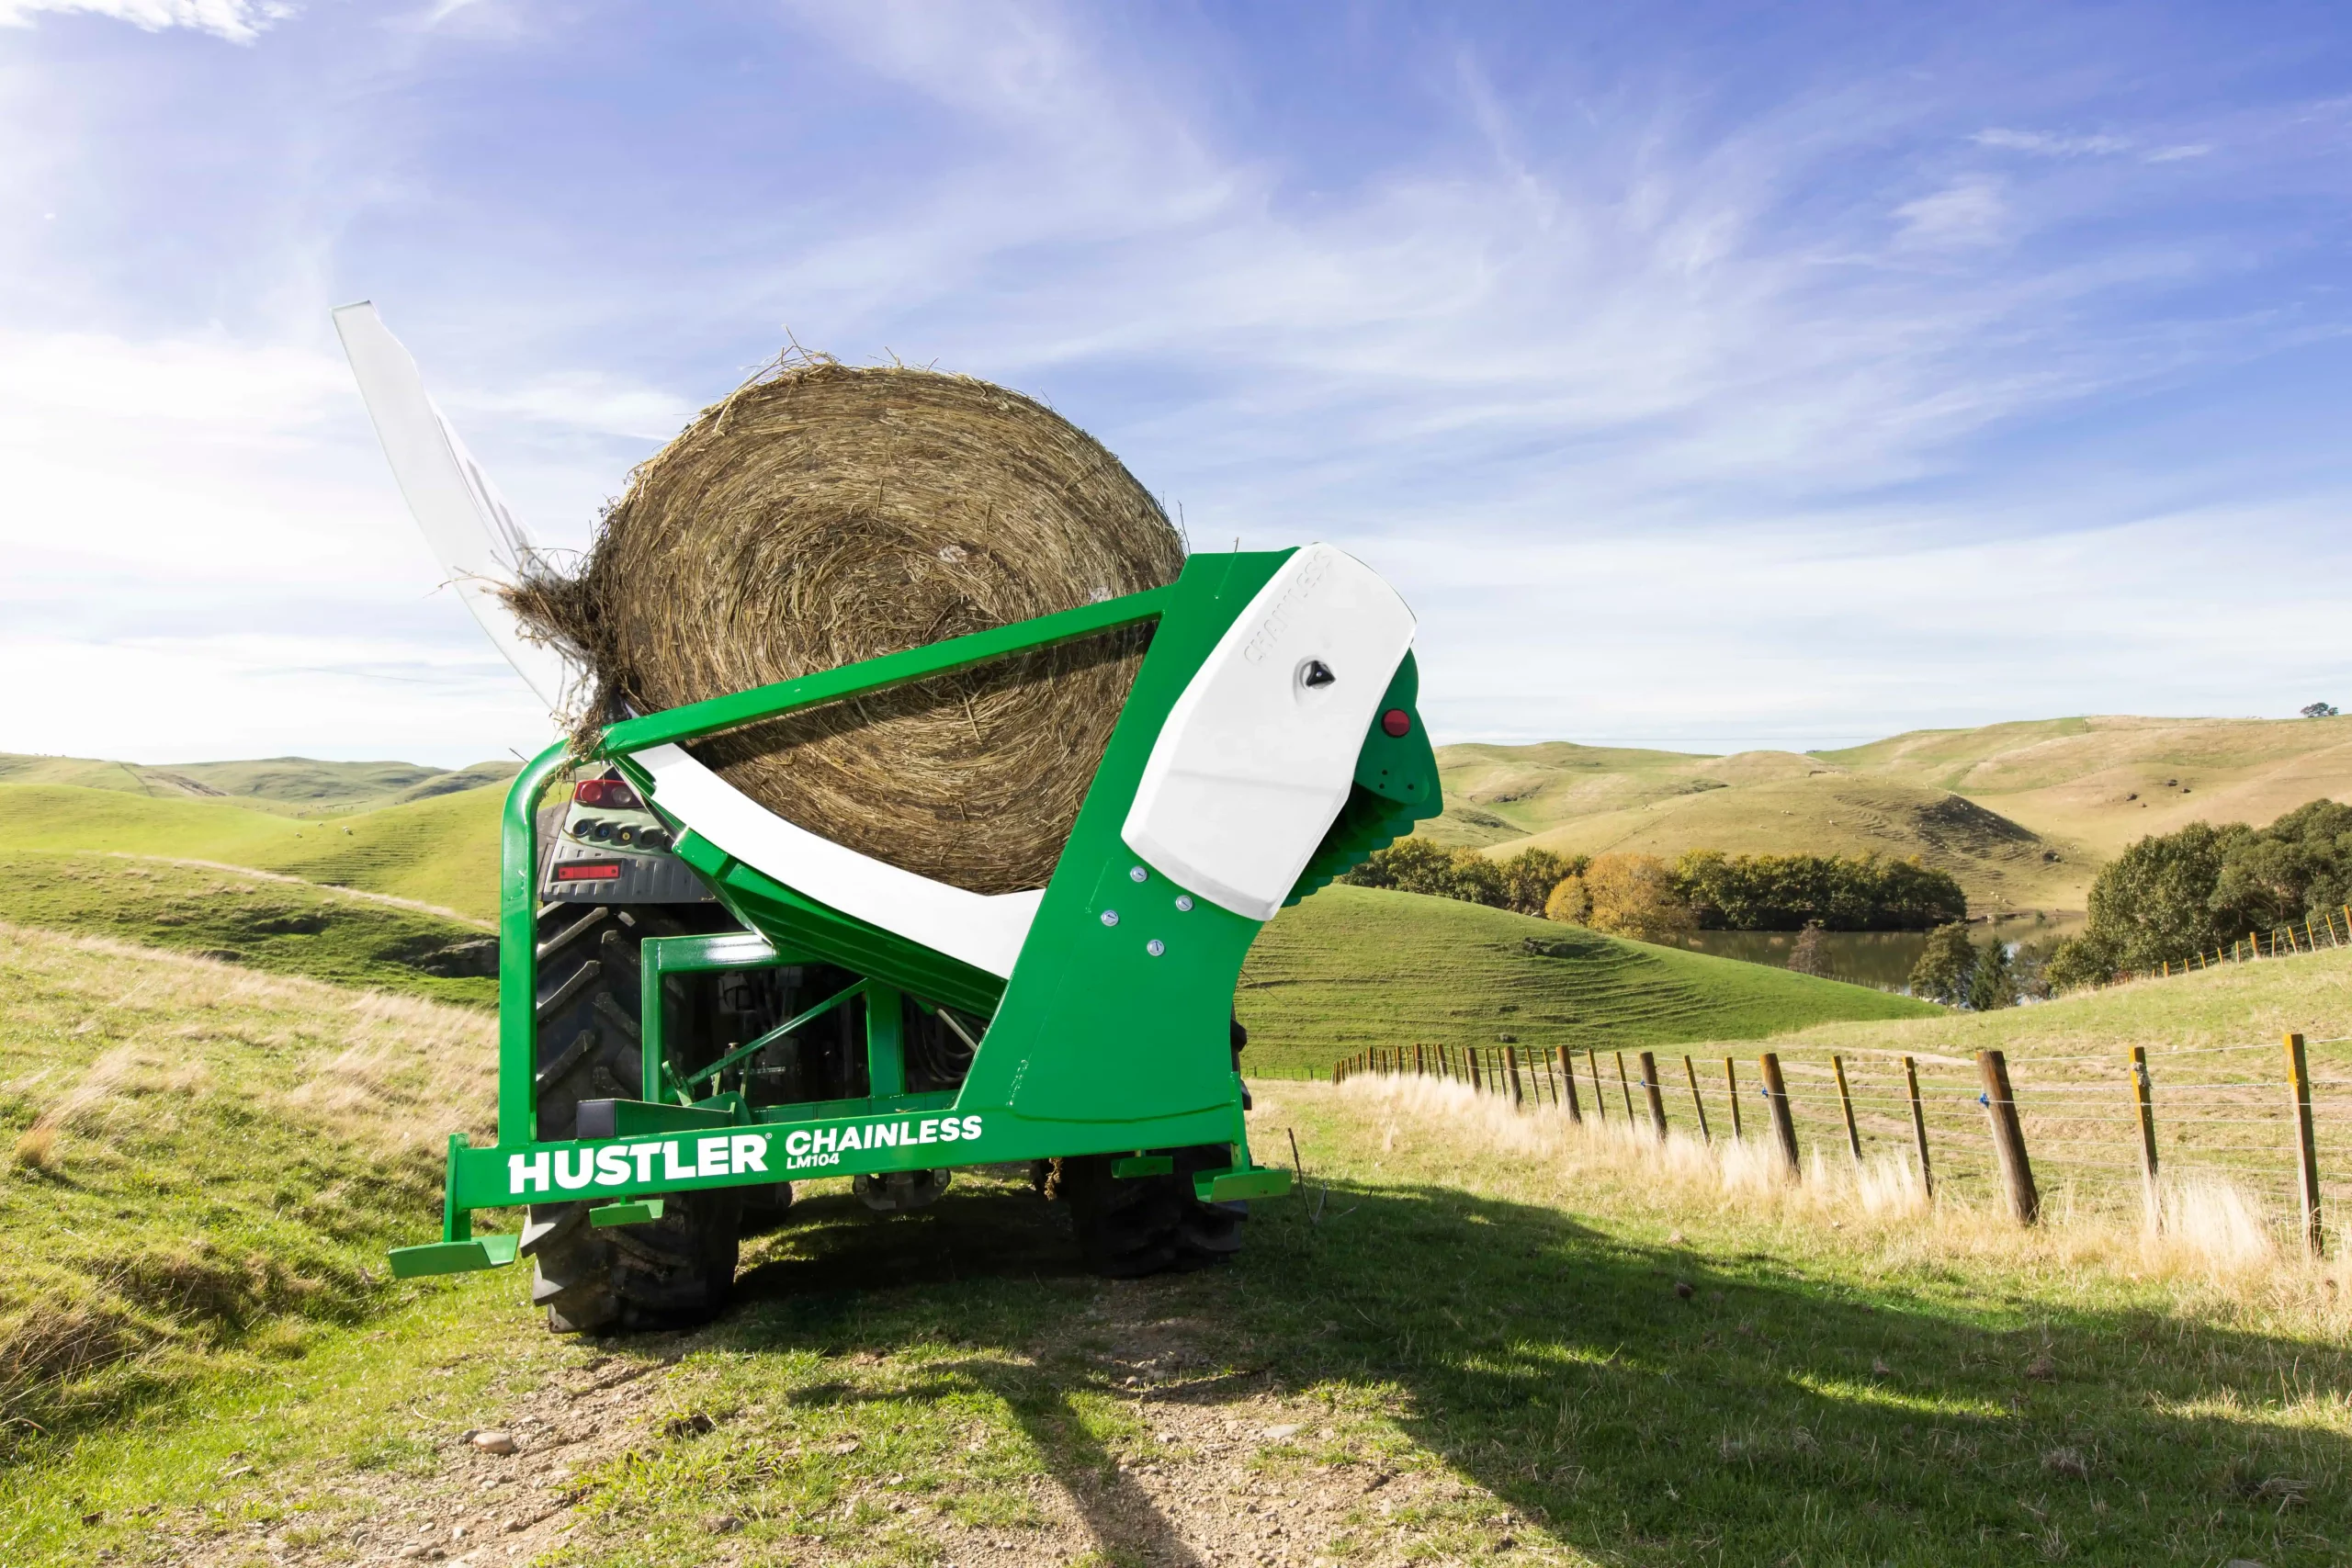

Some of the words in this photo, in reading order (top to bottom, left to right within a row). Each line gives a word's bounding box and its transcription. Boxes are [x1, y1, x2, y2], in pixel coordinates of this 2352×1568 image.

[508, 1134, 769, 1194] HUSTLER
[786, 1115, 982, 1156] CHAINLESS
[786, 1152, 840, 1170] LM104
